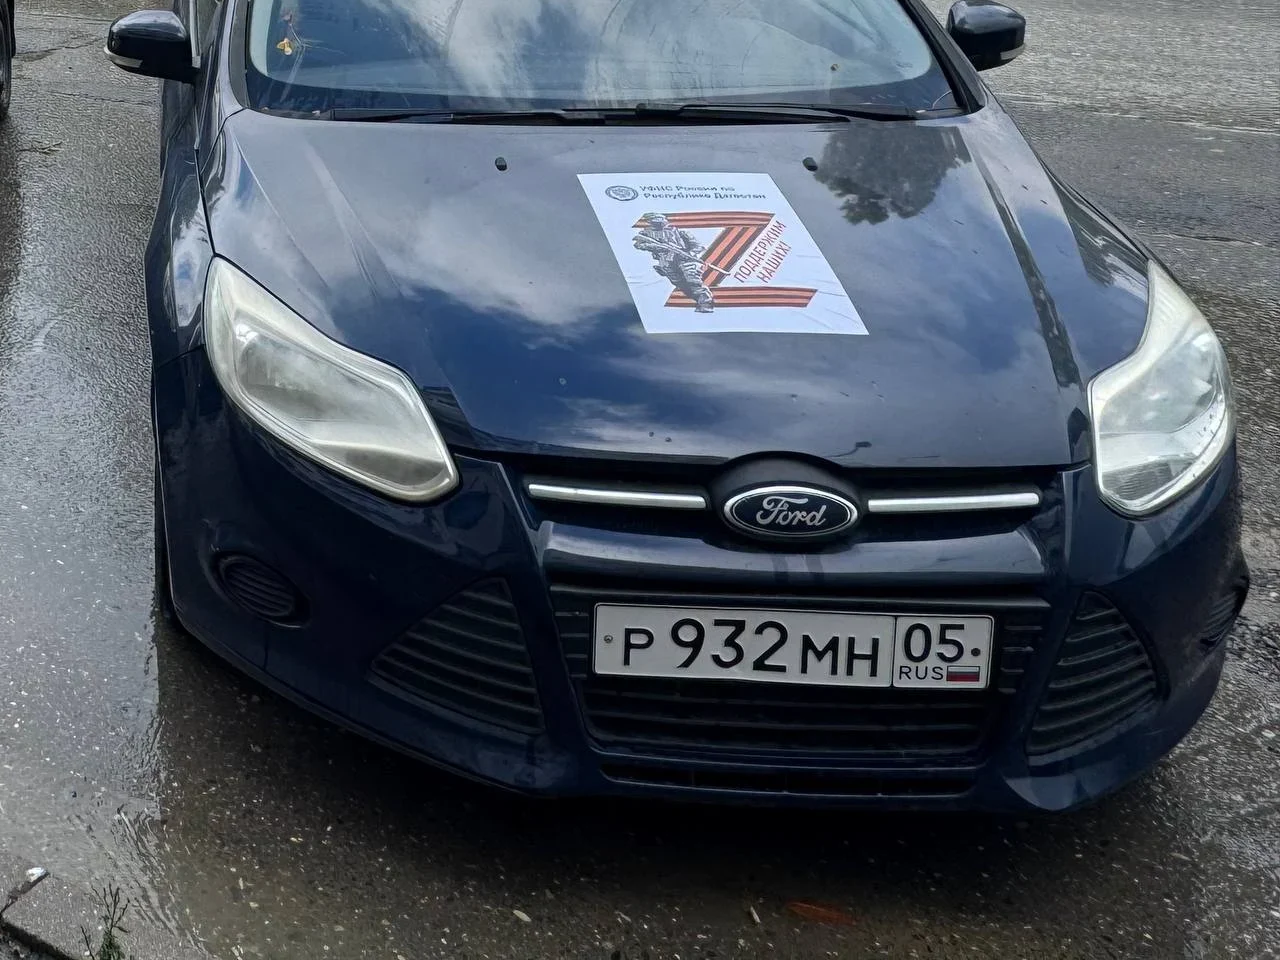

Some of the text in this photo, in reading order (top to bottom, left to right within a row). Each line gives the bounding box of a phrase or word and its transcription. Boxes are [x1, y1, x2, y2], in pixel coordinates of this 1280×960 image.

[733, 220, 787, 283] ПОДДЕРЖИМ
[755, 495, 827, 528] Ford
[903, 622, 966, 663] 05
[898, 664, 944, 682] RUS
